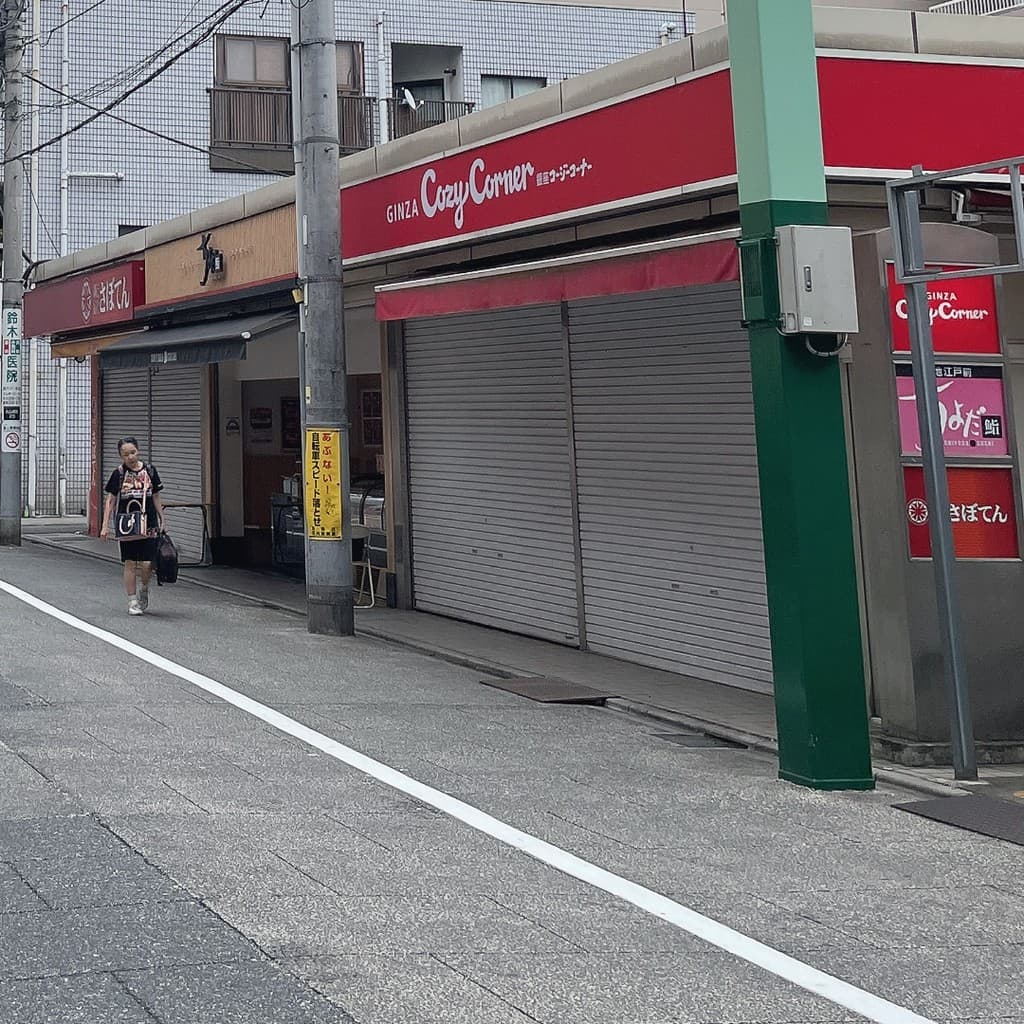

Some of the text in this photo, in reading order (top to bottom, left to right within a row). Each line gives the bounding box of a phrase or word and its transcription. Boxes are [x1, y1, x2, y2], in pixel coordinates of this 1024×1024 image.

[386, 198, 419, 224] GINZA
[420, 168, 471, 230] Cozy
[468, 157, 535, 205] Corner
[99, 276, 130, 313] さぼてん
[938, 302, 989, 320] Corner
